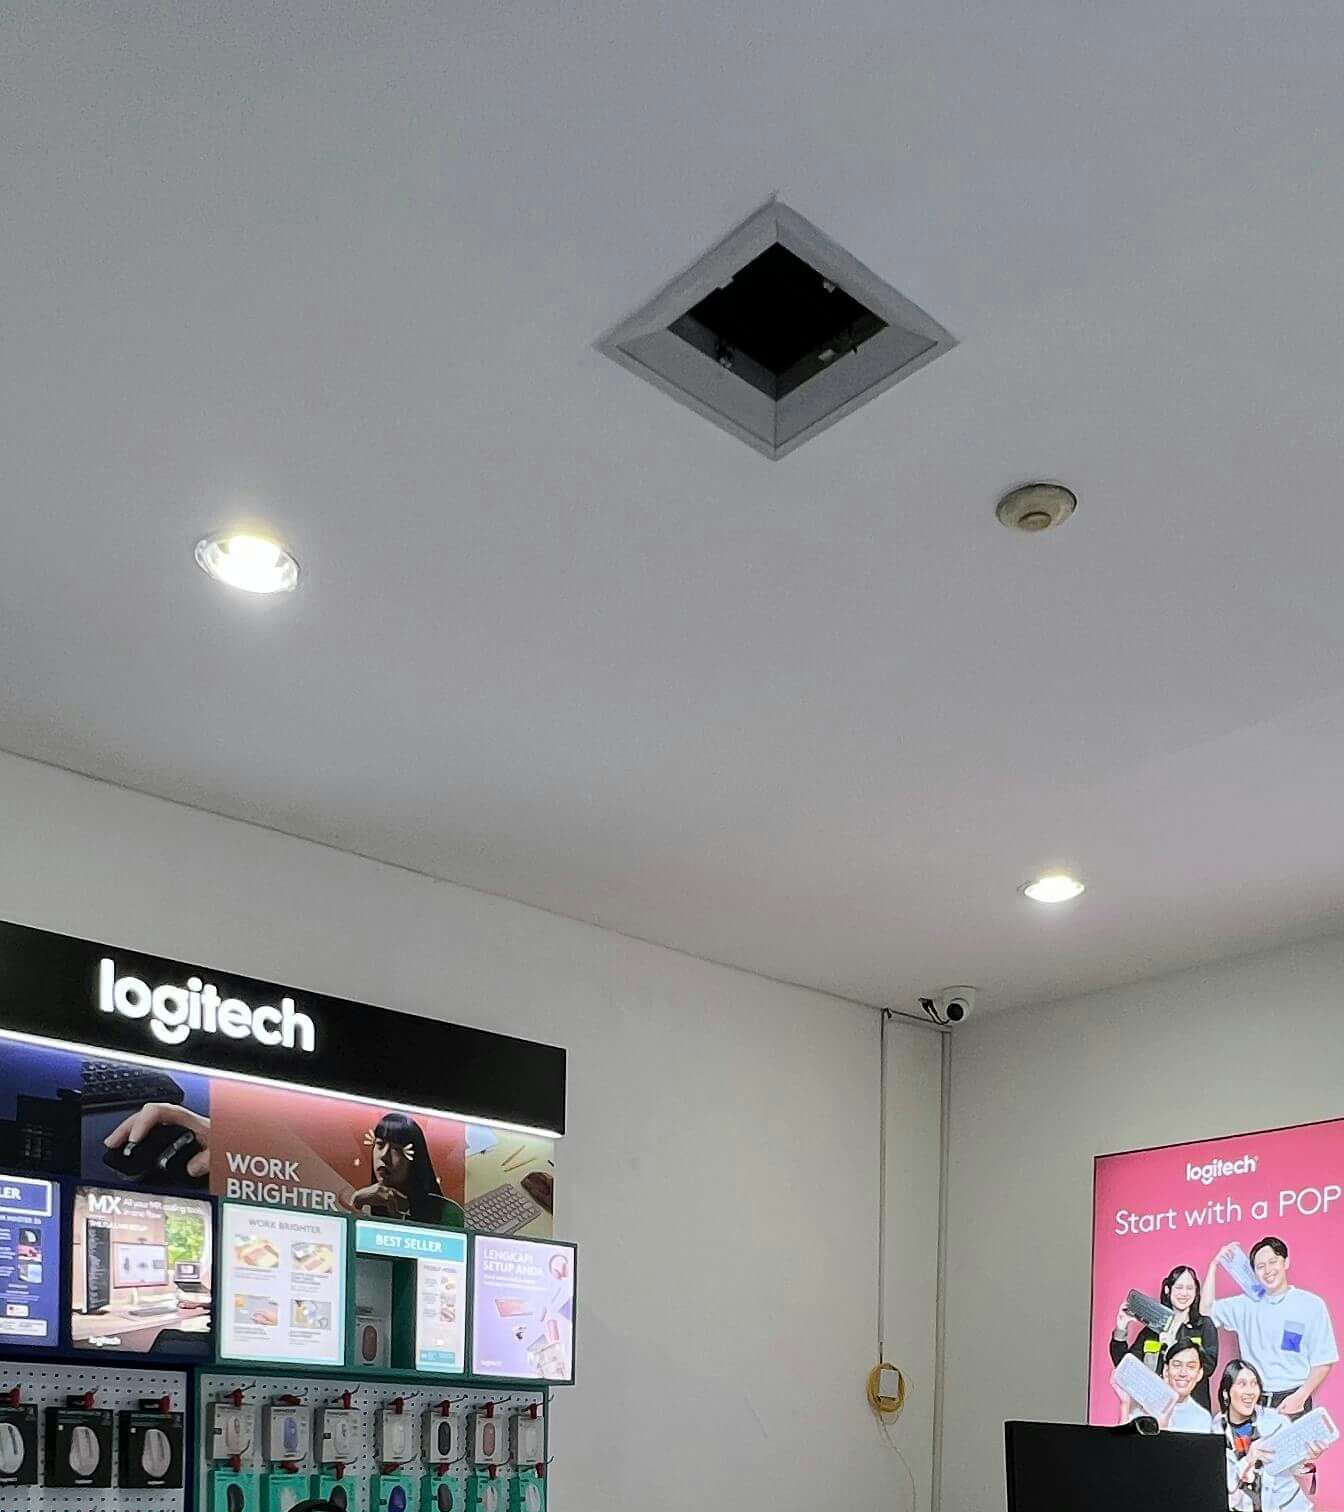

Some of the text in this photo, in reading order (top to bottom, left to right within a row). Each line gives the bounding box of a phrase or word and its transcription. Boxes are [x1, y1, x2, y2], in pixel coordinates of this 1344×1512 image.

[98, 958, 316, 1052] logitech
[225, 1151, 301, 1183] WORK
[1184, 1155, 1258, 1184] logitech
[87, 1193, 122, 1215] MX
[225, 1178, 339, 1213] BRIGHTER
[1114, 1184, 1342, 1236] Start with a POP
[375, 1233, 443, 1253] BEST SELLER
